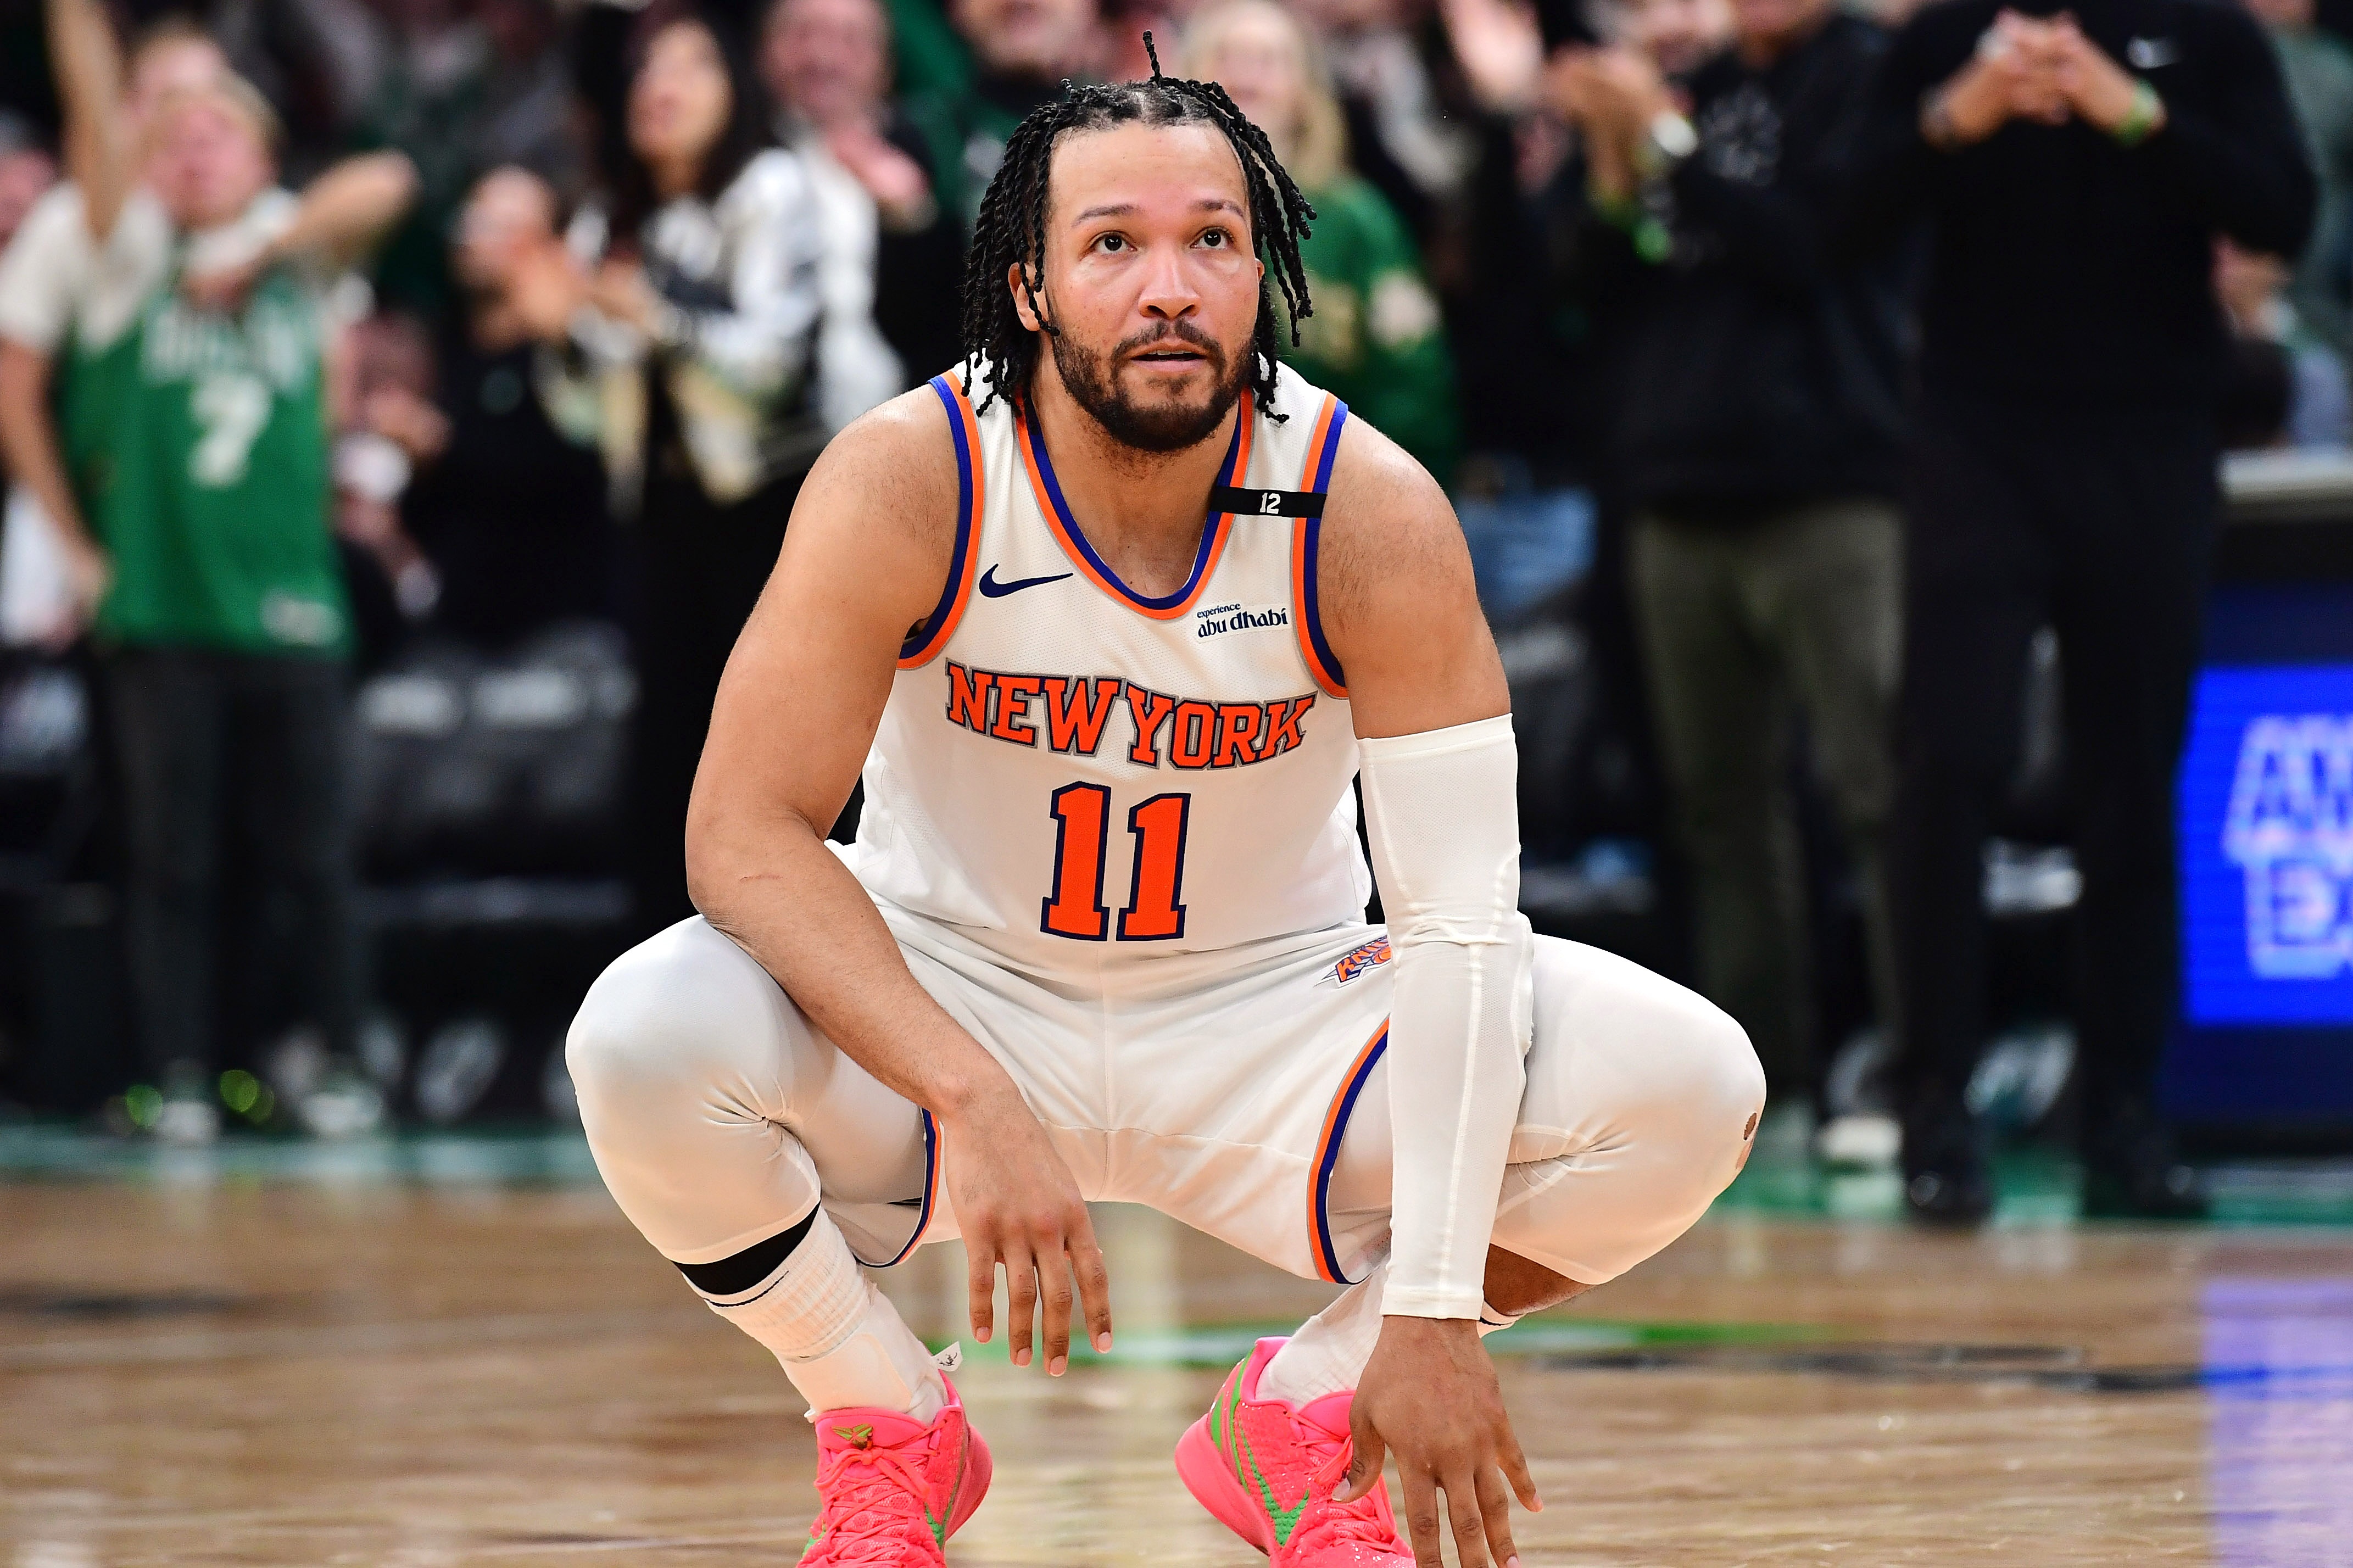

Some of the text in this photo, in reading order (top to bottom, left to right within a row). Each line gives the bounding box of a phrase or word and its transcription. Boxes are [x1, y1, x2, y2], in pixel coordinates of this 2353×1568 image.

[189, 371, 274, 487] 7
[1259, 492, 1281, 515] 12
[1197, 603, 1241, 618] experience
[1198, 619, 1228, 638] abu
[945, 657, 1319, 771] NEW YORK
[1040, 781, 1191, 941] 11
